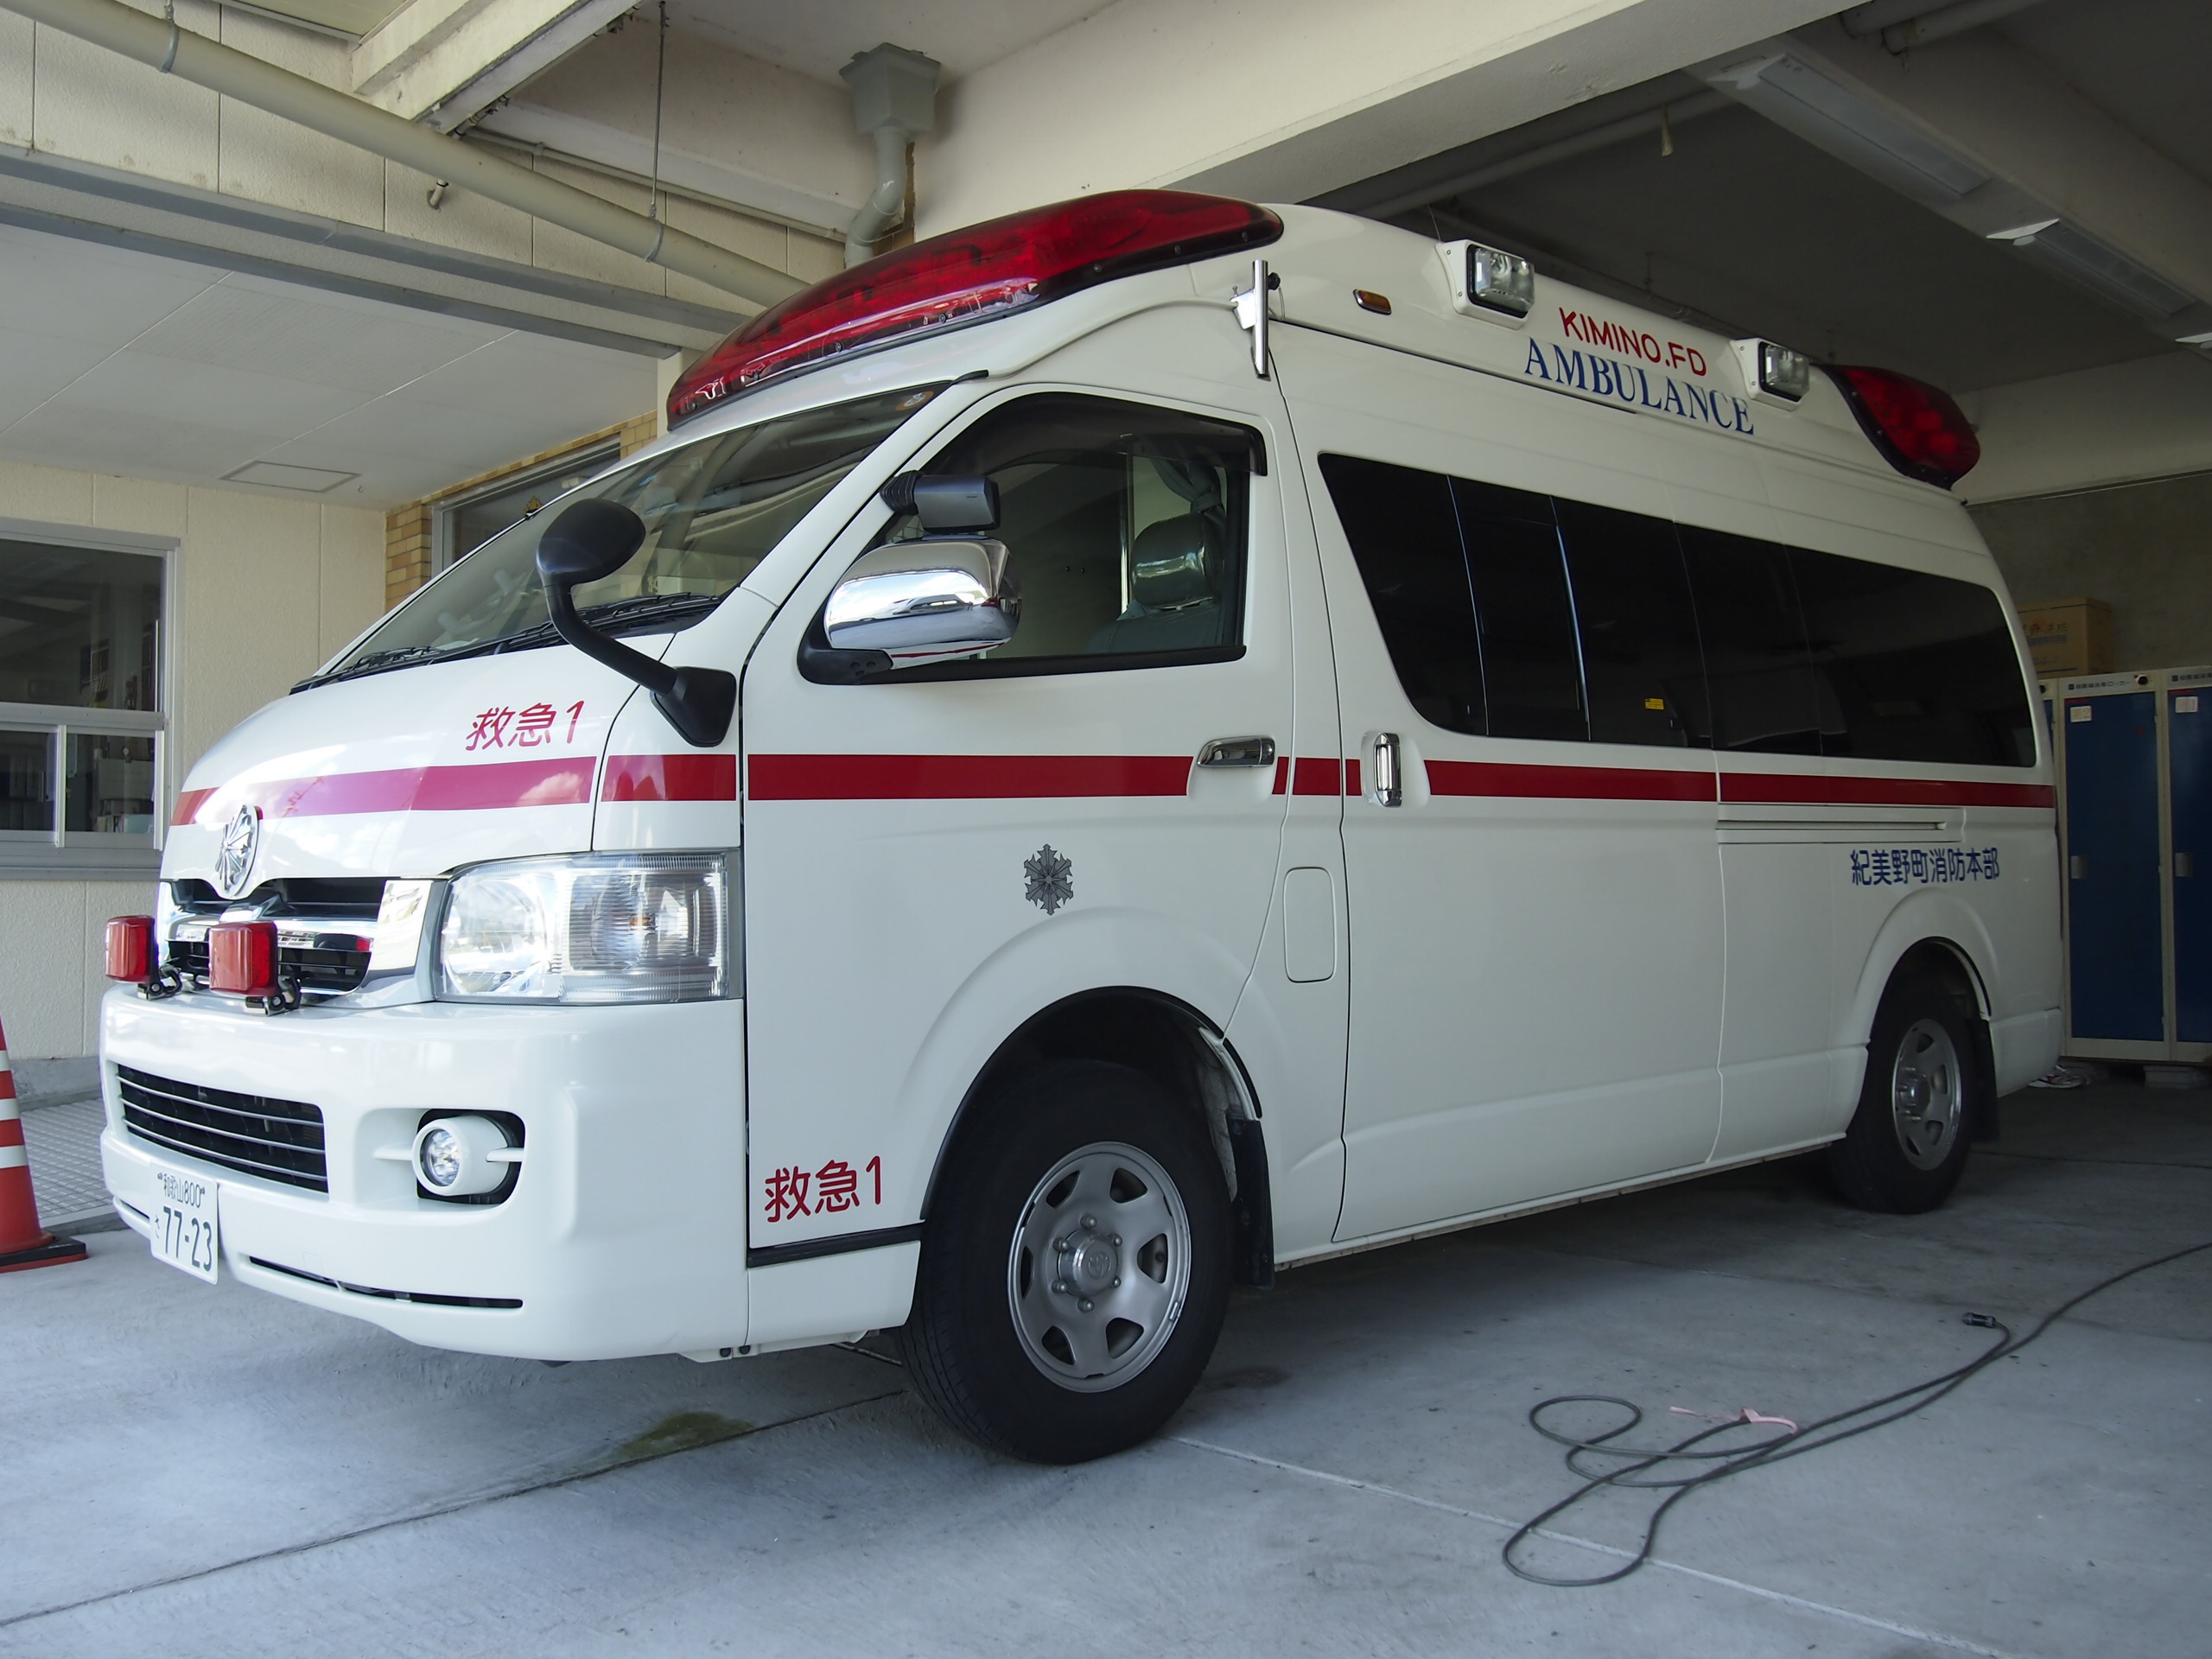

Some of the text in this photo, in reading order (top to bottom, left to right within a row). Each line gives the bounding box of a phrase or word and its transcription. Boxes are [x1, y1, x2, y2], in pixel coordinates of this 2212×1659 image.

[1559, 307, 1707, 377] KIMINO.FD
[1524, 337, 1754, 435] AMBULANCE
[465, 700, 585, 751] 救急1
[1850, 848, 2000, 886] 紀美野町消防本部
[764, 1155, 881, 1223] 救急1
[163, 1205, 213, 1272] 77-23
